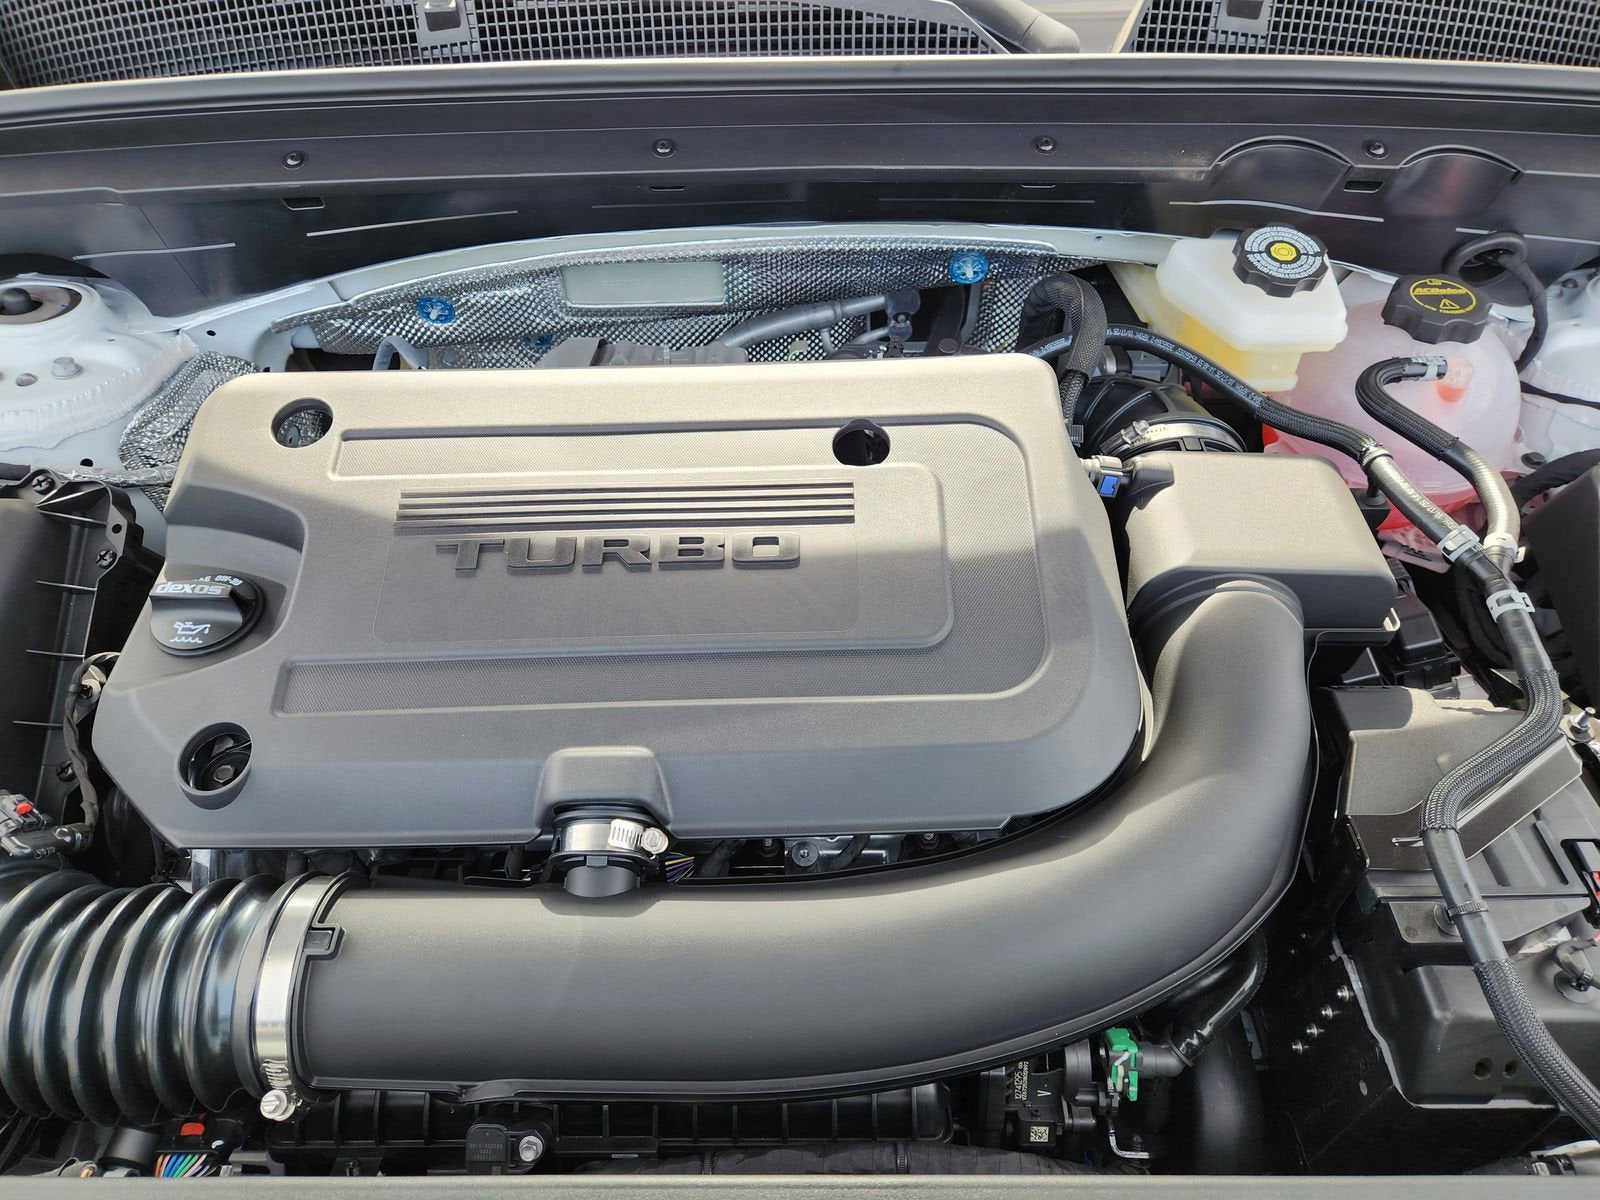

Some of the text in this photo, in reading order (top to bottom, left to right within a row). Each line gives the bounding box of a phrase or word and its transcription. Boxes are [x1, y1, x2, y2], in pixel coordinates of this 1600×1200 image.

[435, 532, 801, 573] TURBO
[215, 574, 243, 586] 0W-20
[156, 581, 224, 595] dexos
